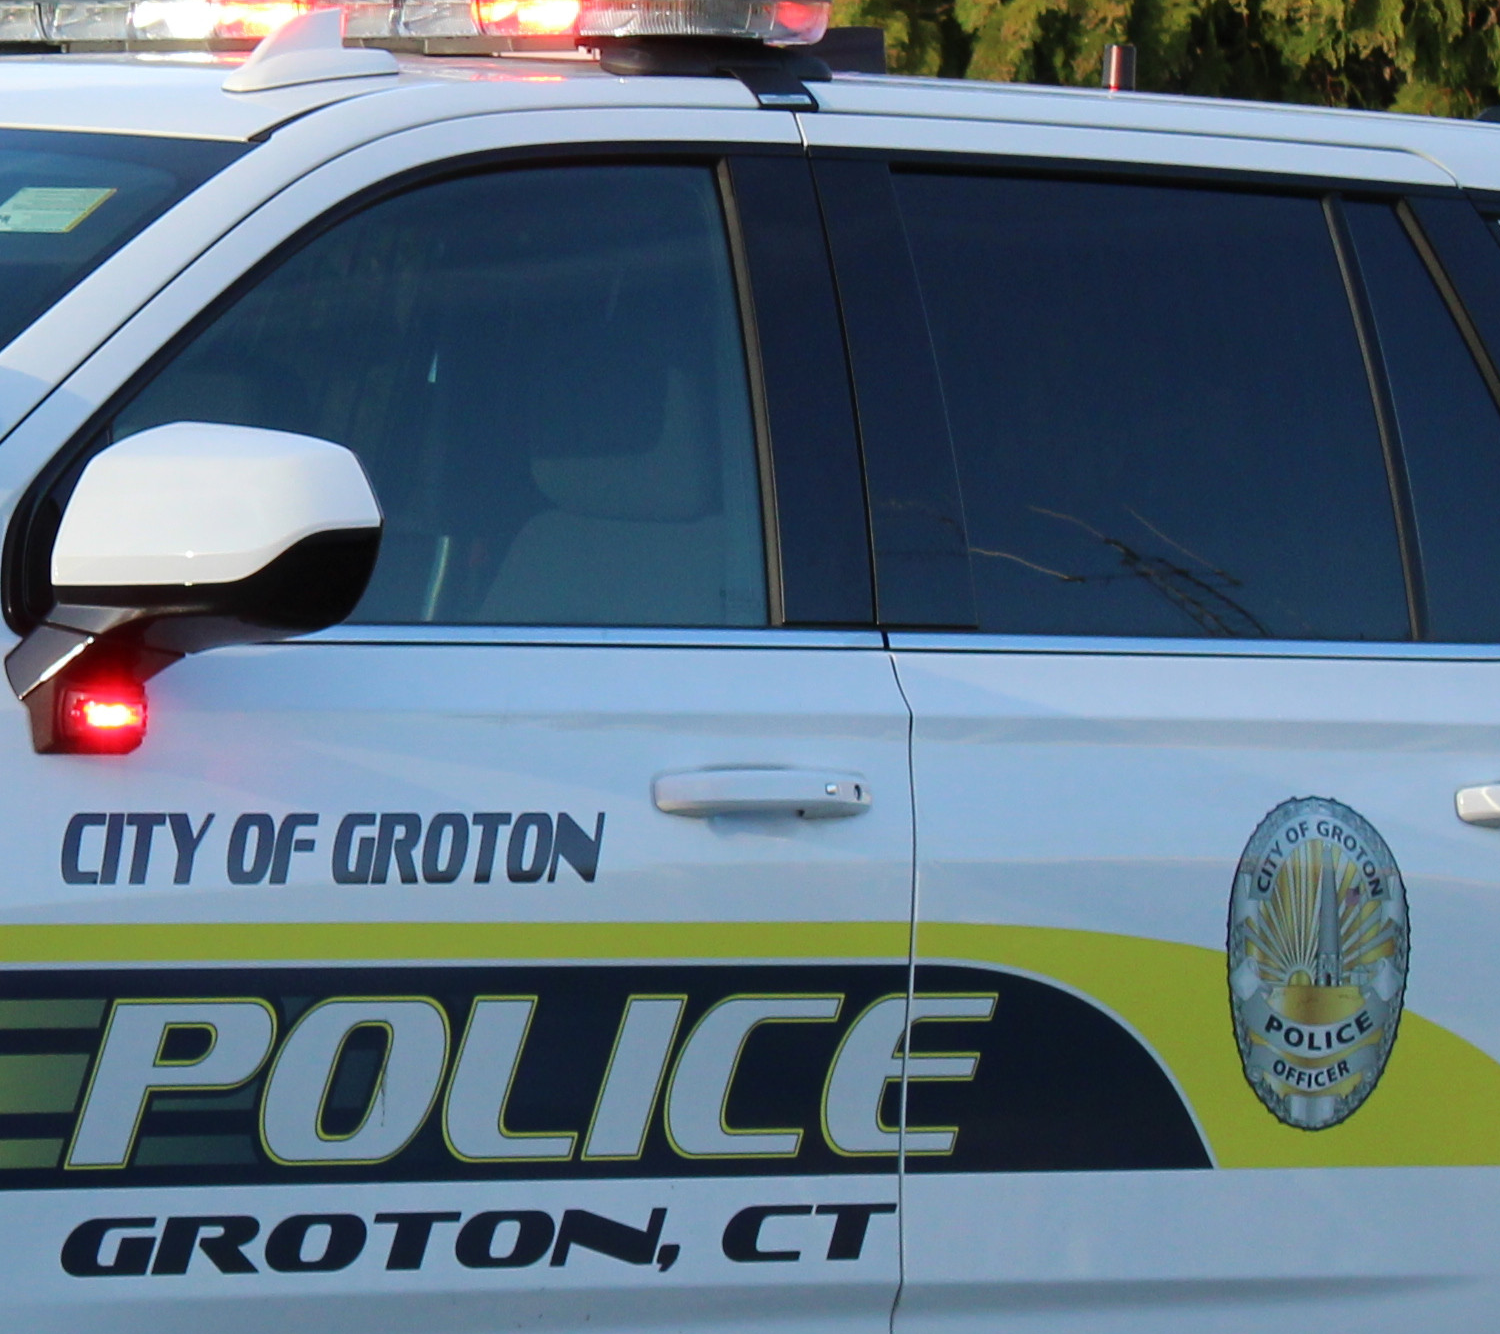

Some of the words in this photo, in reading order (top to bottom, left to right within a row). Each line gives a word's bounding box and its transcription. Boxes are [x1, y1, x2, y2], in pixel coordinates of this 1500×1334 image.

[60, 812, 215, 885] CITY
[226, 812, 319, 885] OF
[331, 812, 606, 884] GROTON
[1257, 840, 1284, 893] CITY
[1286, 821, 1309, 844] OF
[1316, 820, 1384, 897] GROTON
[1264, 1010, 1373, 1051] POLICE
[64, 993, 999, 1170] POLICE
[1272, 1060, 1350, 1088] OFFICER
[60, 1207, 681, 1277] GROTON,
[721, 1203, 898, 1262] CT
